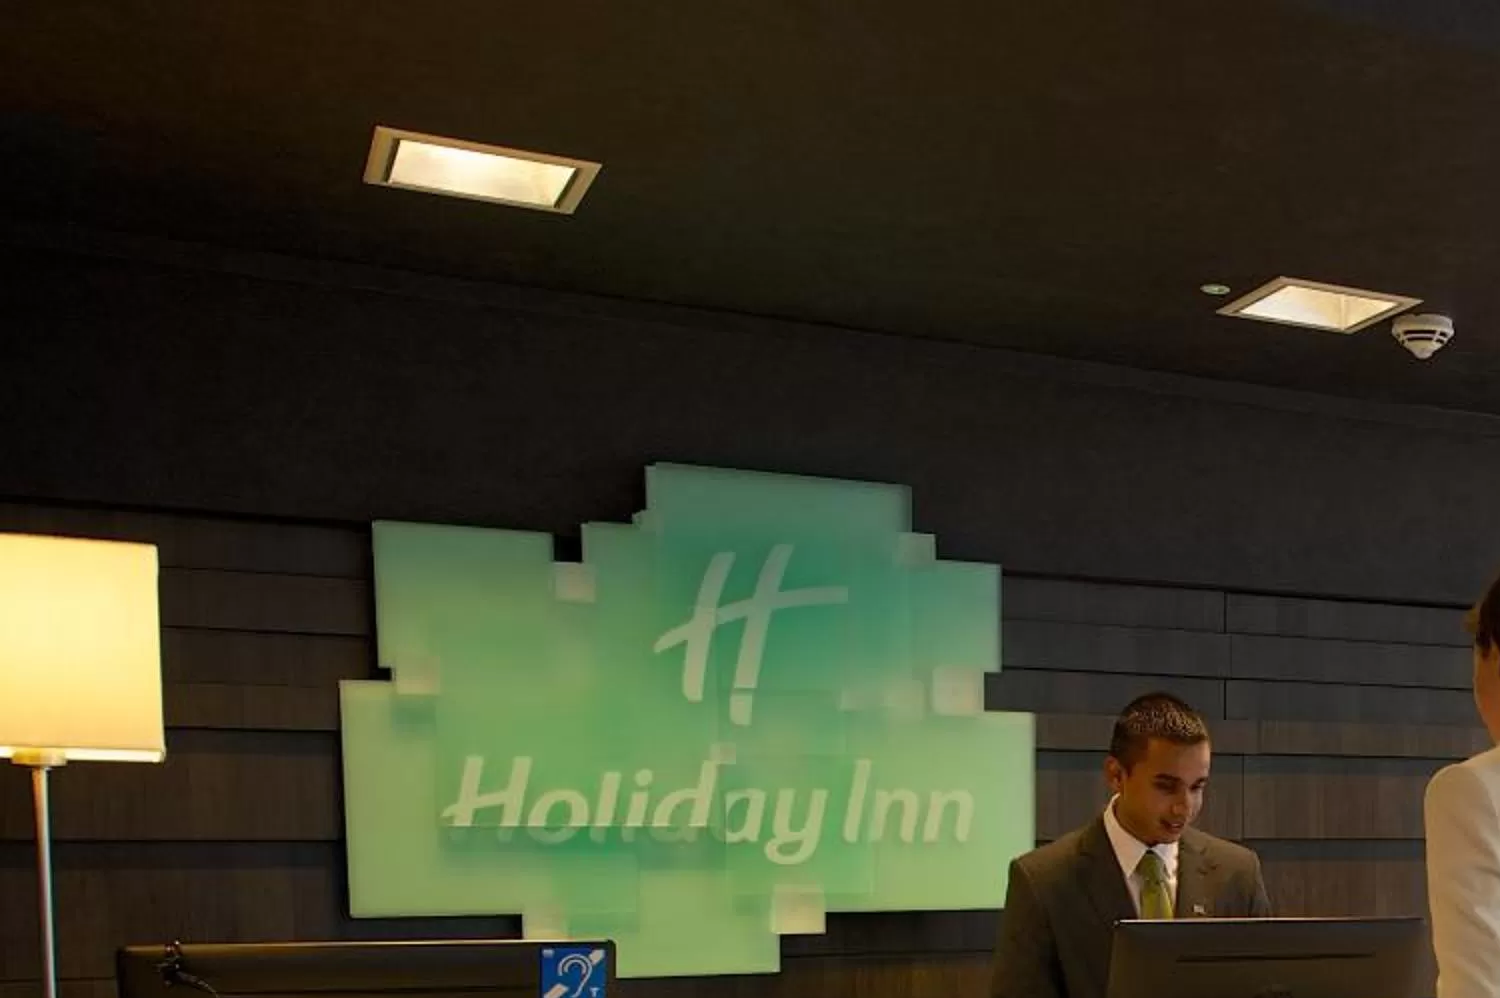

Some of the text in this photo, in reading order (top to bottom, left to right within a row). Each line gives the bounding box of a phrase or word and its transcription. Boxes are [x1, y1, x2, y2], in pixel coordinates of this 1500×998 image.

[653, 543, 849, 726] H
[442, 755, 974, 866] Holiday Inn
